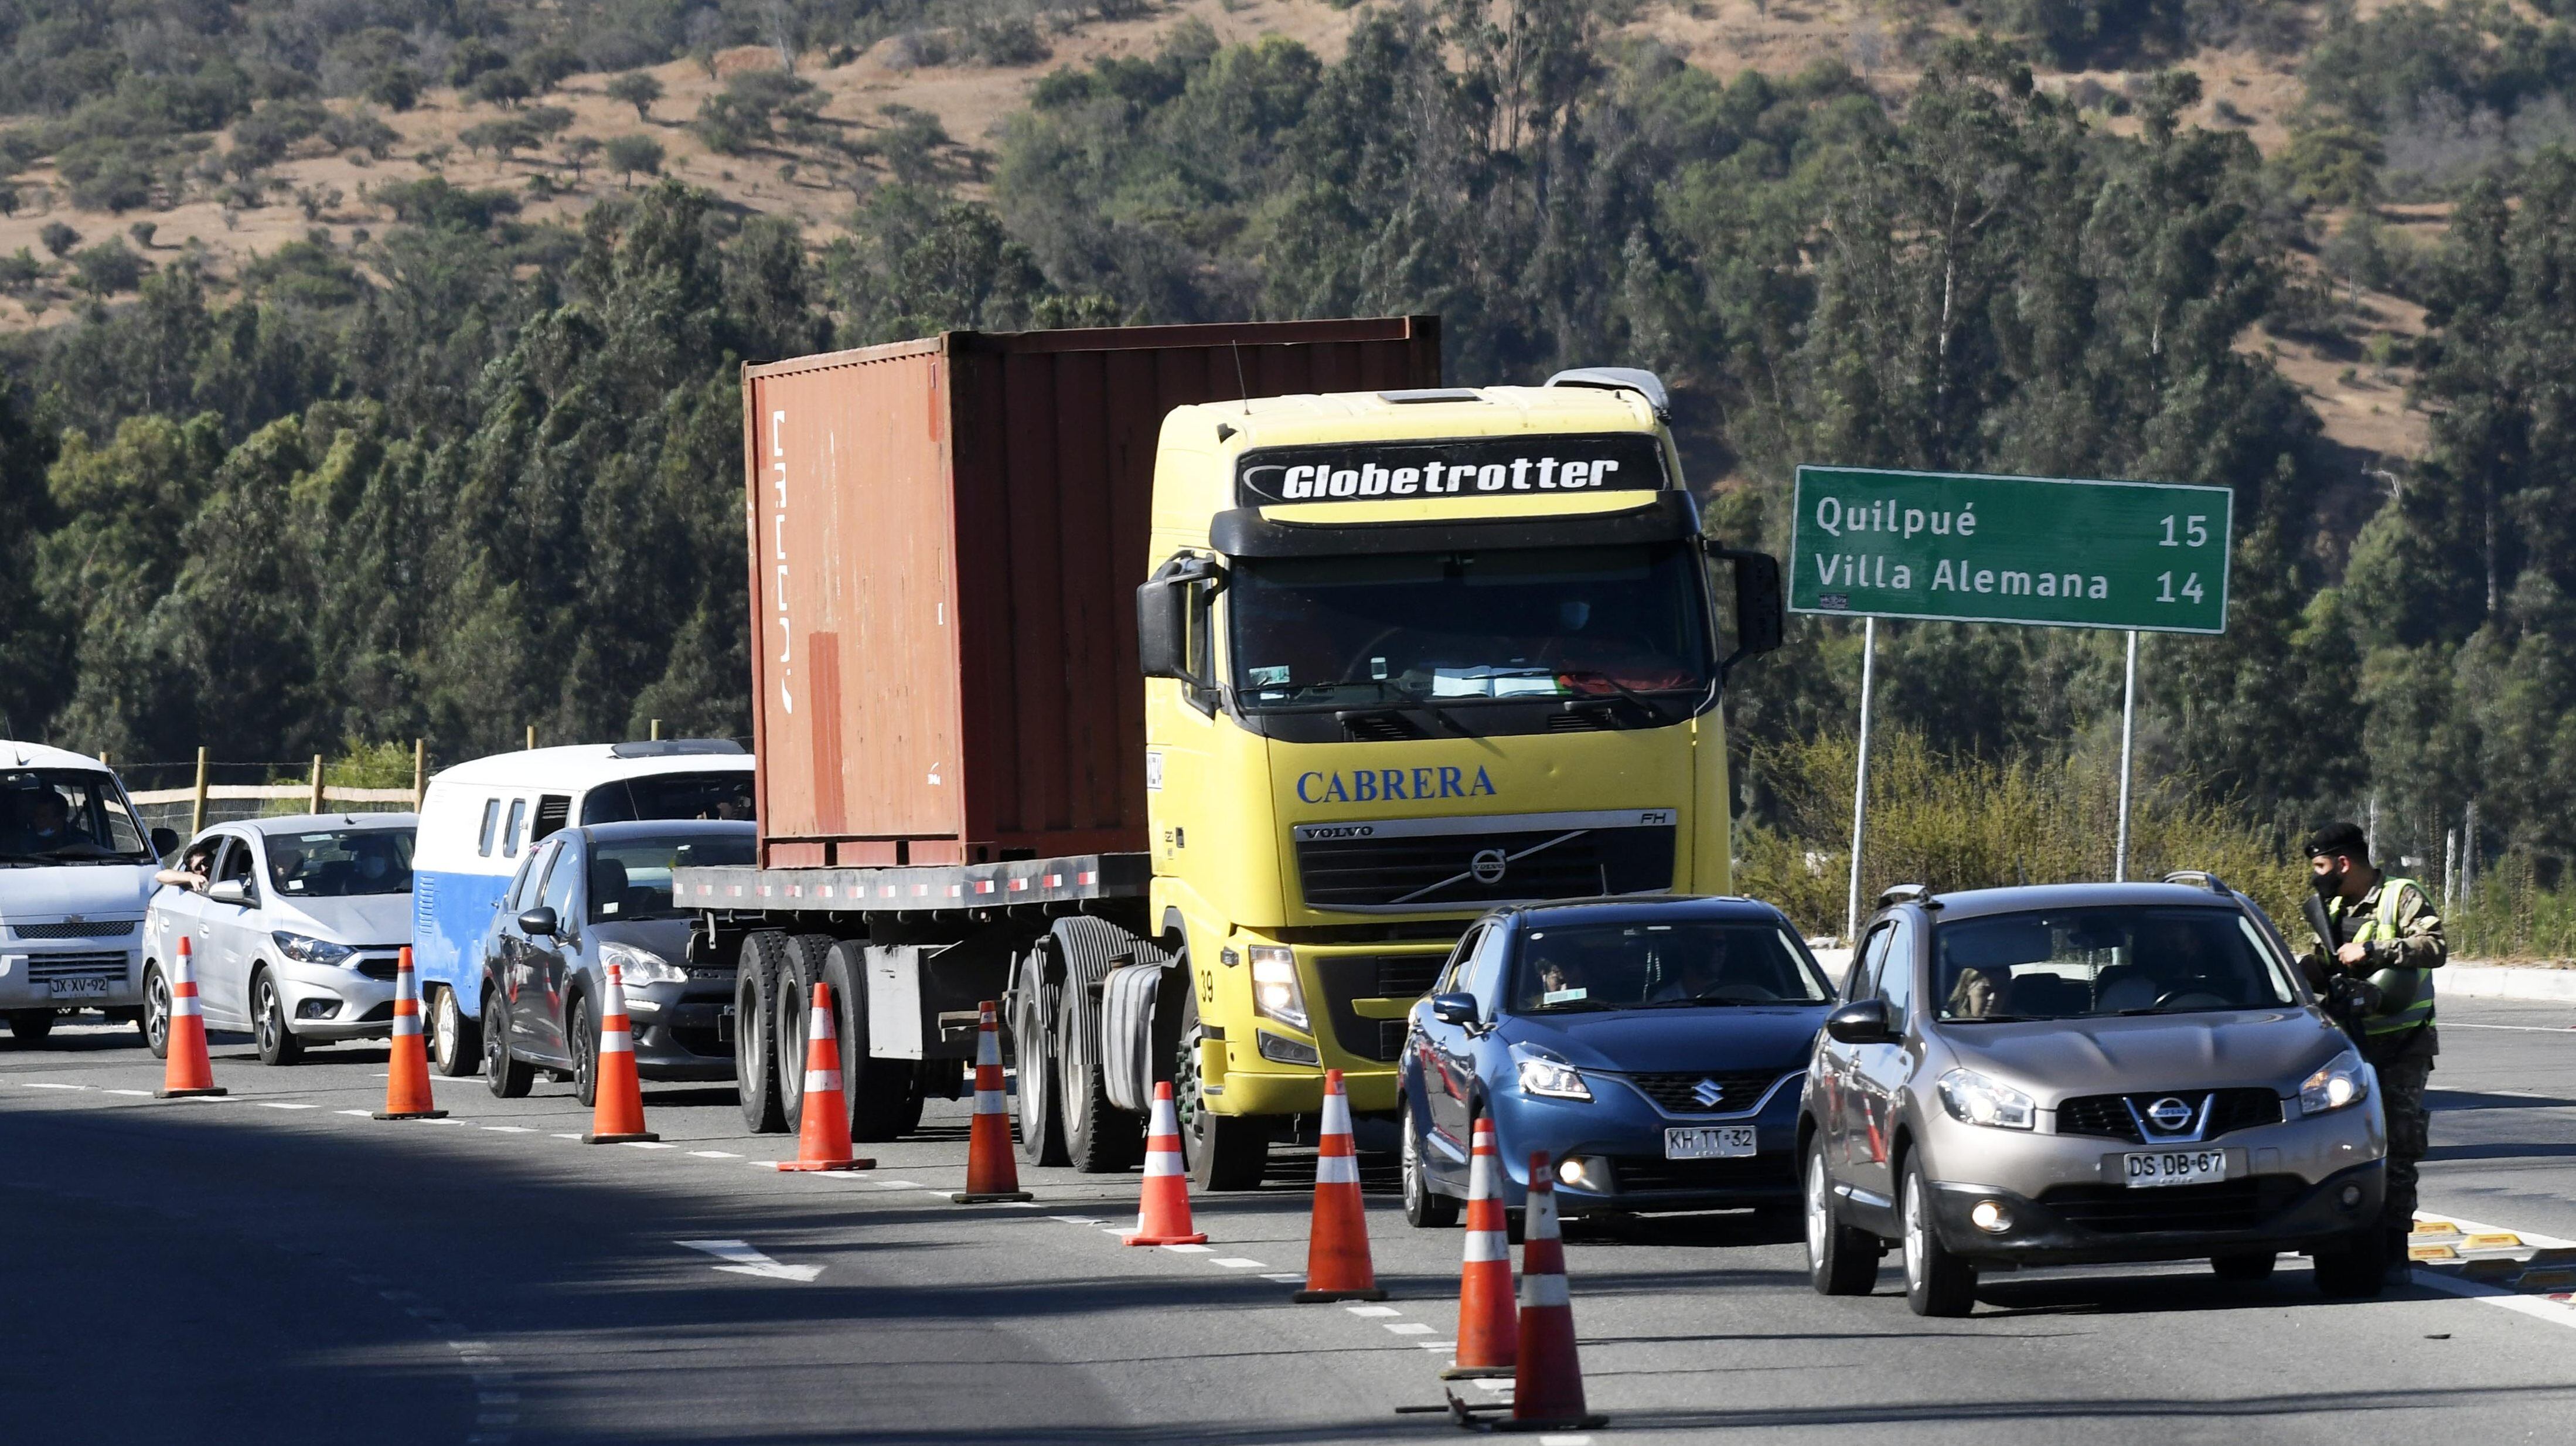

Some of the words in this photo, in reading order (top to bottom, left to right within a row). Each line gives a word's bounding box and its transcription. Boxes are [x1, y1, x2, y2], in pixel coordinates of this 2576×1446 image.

[1282, 457, 1619, 499] Globetrotter
[1816, 496, 1977, 539] Quilpué
[2158, 514, 2207, 547] 15
[1815, 553, 1911, 590] Villa
[1930, 559, 2108, 600] Alemana
[2155, 570, 2204, 604] 14
[1296, 764, 1498, 804] CABRERA
[1302, 826, 1374, 839] VOLVO
[1641, 812, 1667, 824] FH
[1201, 969, 1213, 1003] 39
